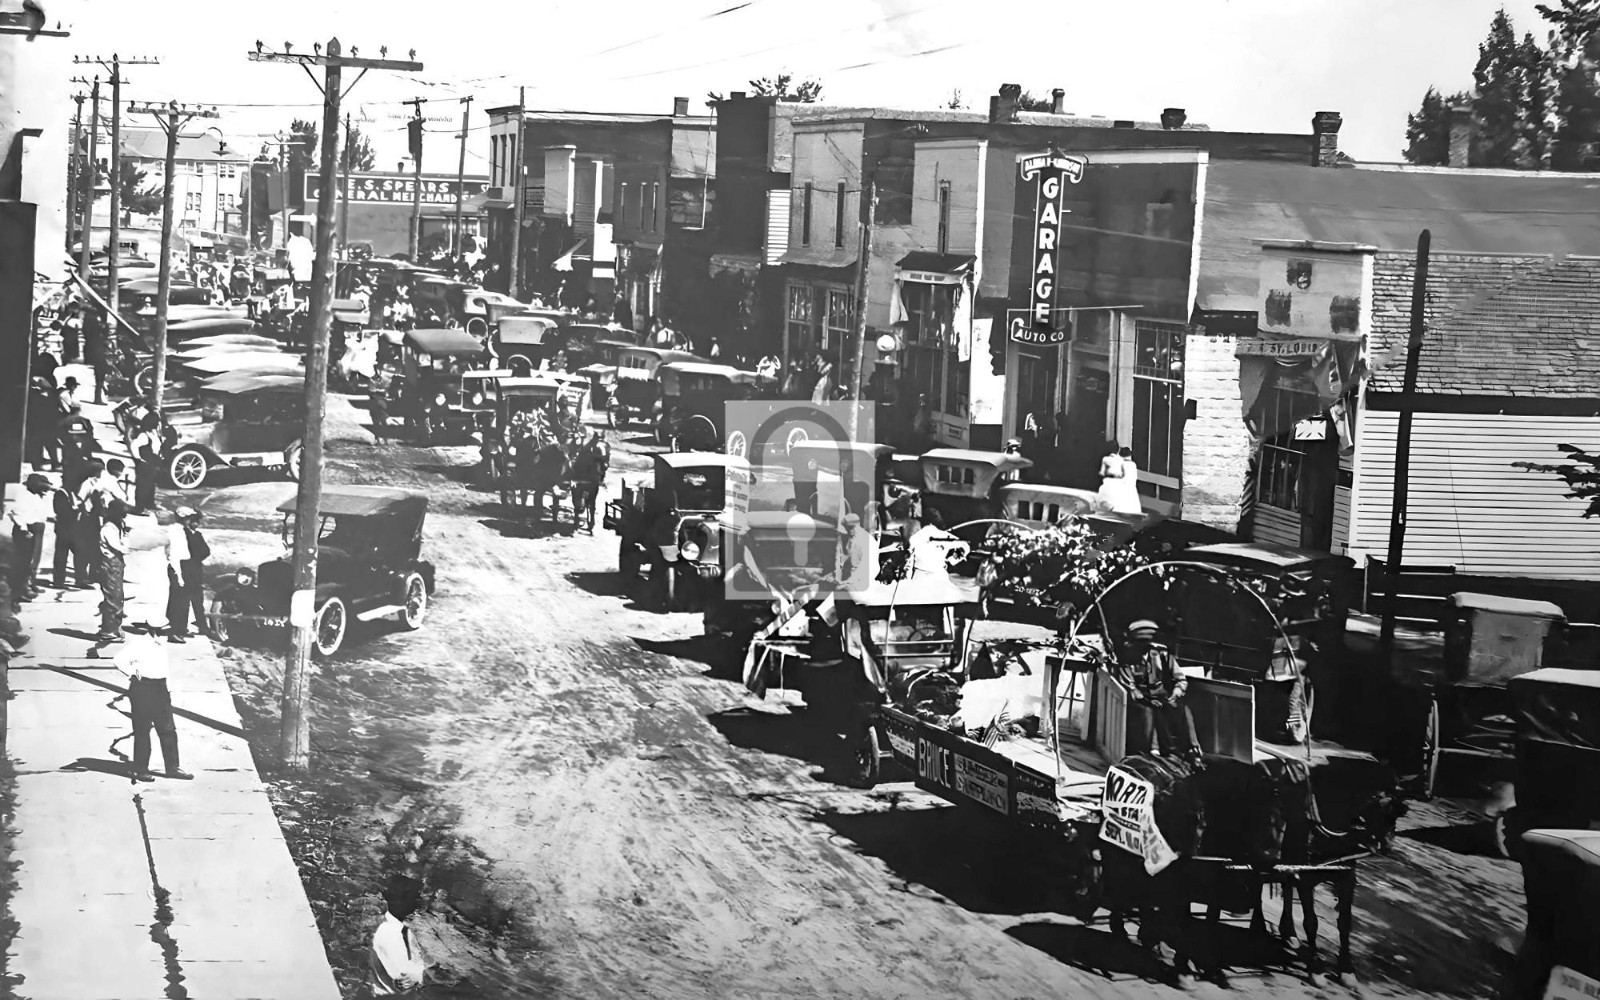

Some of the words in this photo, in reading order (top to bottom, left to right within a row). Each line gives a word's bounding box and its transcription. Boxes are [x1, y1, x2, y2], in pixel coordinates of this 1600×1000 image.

[313, 188, 389, 200] GNERAL
[1035, 177, 1059, 323] GARAGE
[1014, 328, 1046, 343] AUTO
